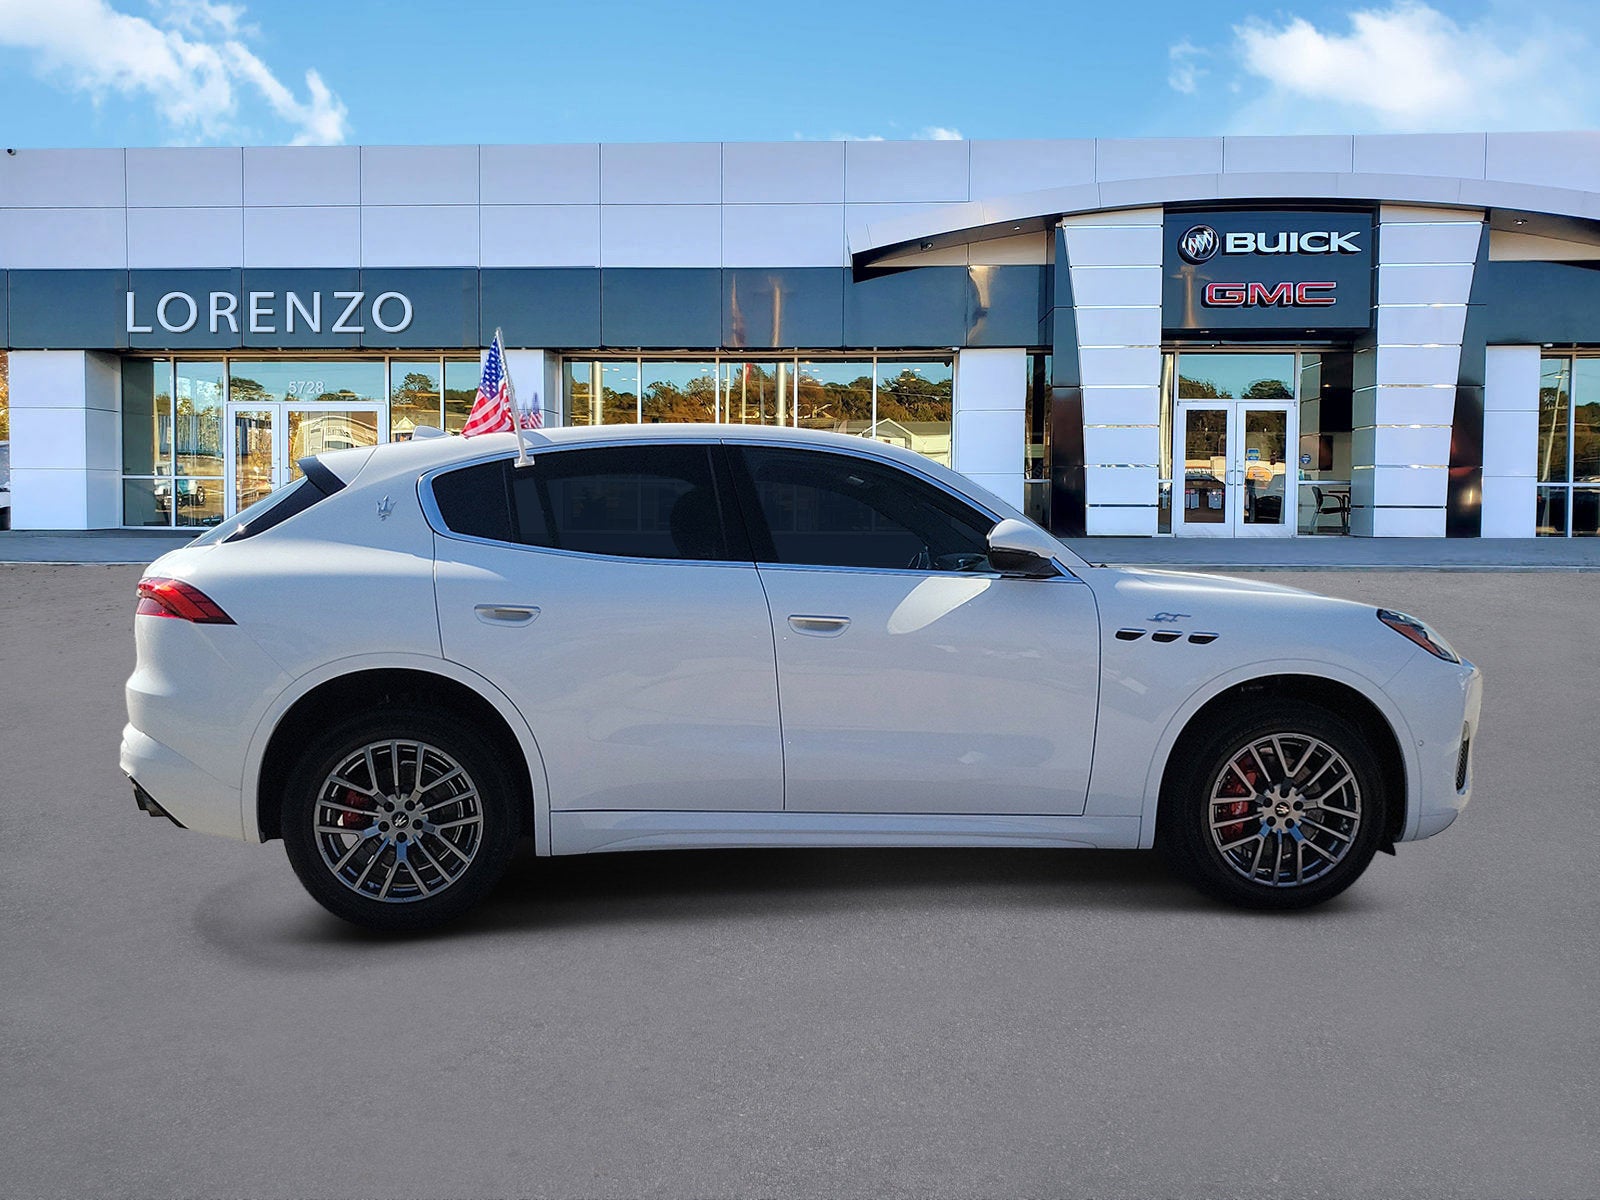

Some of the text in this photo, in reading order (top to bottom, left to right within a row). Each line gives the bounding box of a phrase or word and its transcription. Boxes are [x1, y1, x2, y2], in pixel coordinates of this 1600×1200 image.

[1225, 231, 1362, 253] BUICK
[1204, 281, 1337, 305] GMC
[126, 291, 413, 333] LORENZO
[287, 381, 325, 394] 5728
